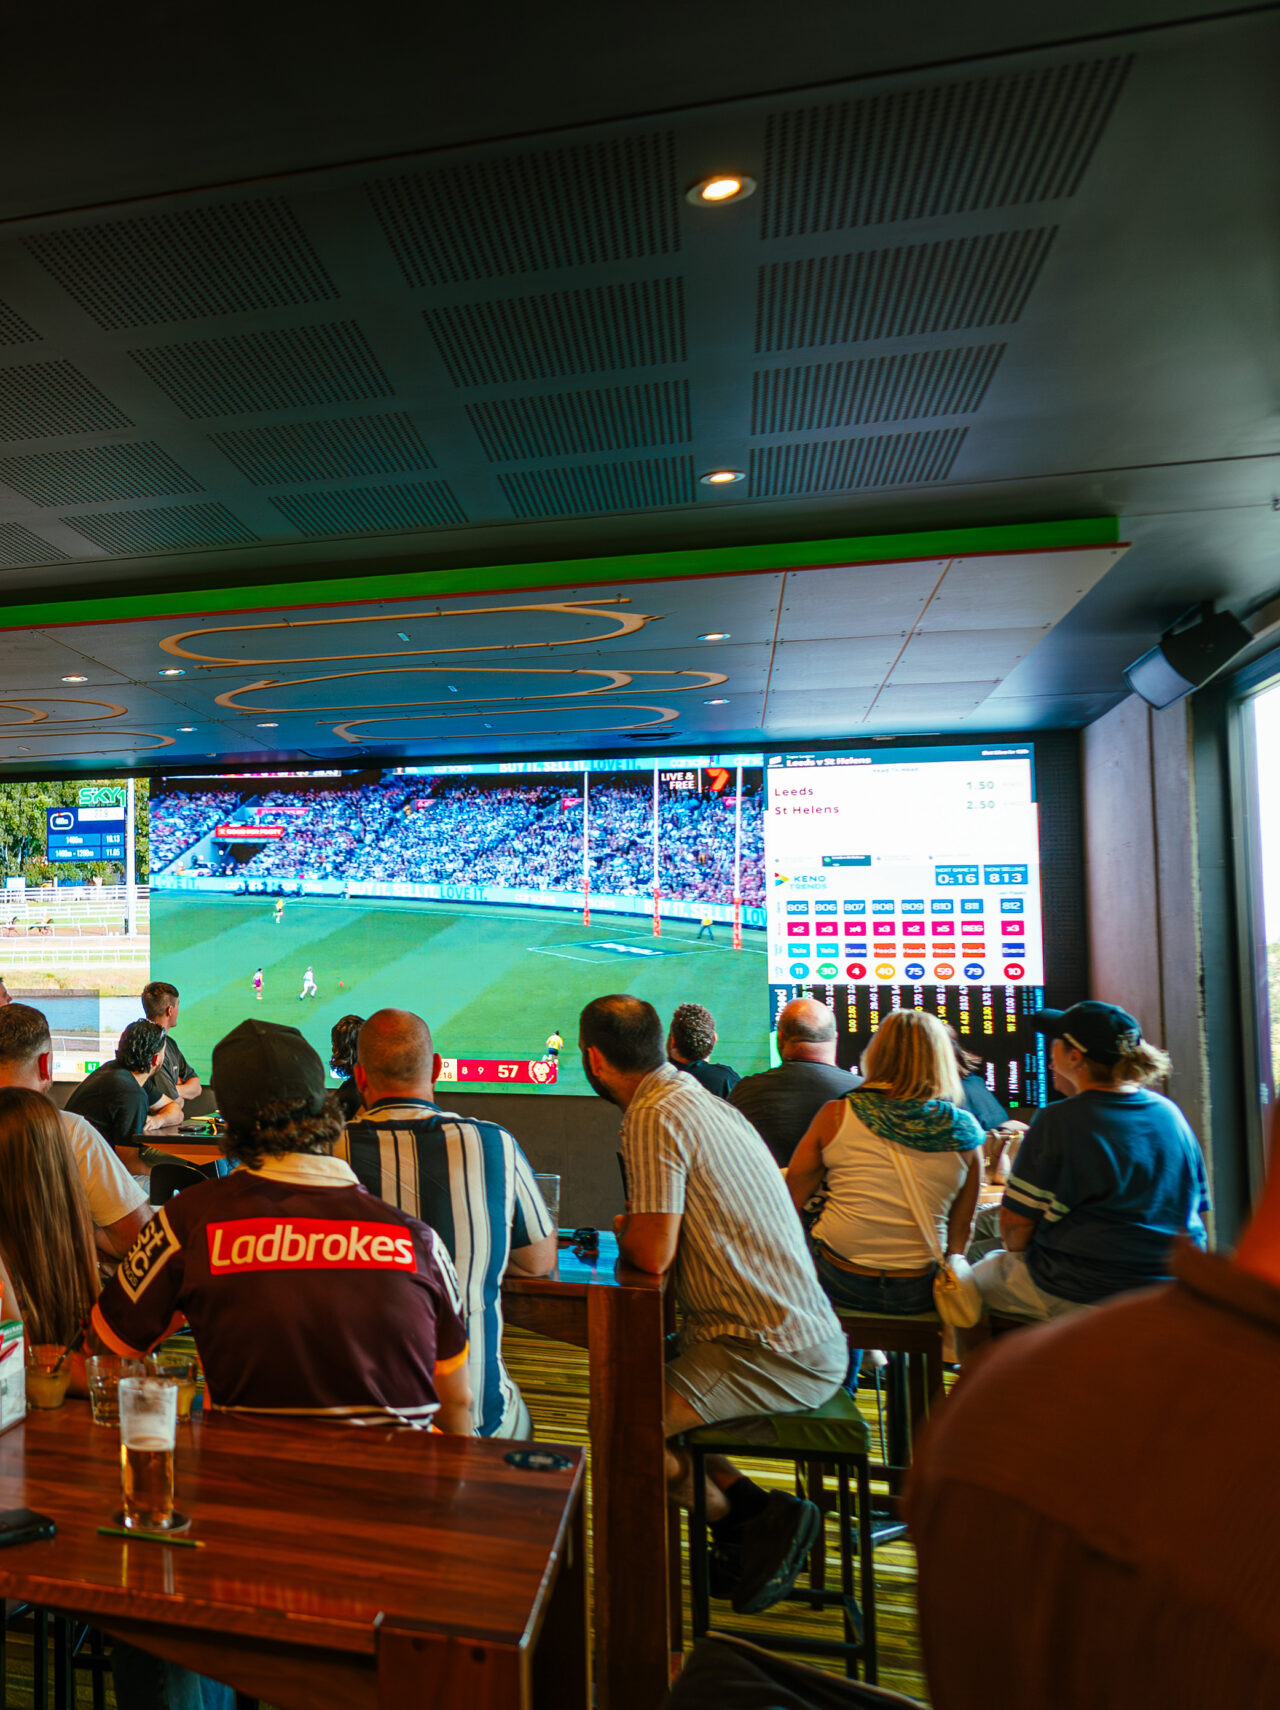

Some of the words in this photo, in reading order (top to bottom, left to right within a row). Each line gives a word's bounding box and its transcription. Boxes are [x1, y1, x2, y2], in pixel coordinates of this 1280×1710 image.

[662, 772, 684, 781] LIVE
[685, 772, 694, 780] &
[670, 780, 694, 790] FREE
[774, 787, 814, 796] Leeds
[775, 806, 788, 815] St
[793, 805, 839, 814] Helens
[966, 800, 995, 810] 2.50
[937, 874, 976, 884] 0:16
[989, 873, 1023, 883] 813
[440, 886, 468, 899] LOVE
[787, 904, 808, 912] 805
[844, 903, 864, 911] 807
[1002, 902, 1020, 910] 812
[820, 967, 836, 975] 30
[852, 967, 860, 975] 4
[877, 967, 894, 975] 40
[907, 967, 923, 975] 75
[936, 967, 952, 975] 59
[967, 967, 983, 975] 79
[1007, 967, 1021, 975] 10
[461, 1066, 468, 1075] 8
[478, 1066, 484, 1075] 9
[498, 1064, 519, 1078] 57
[211, 1225, 413, 1266] Ladbrokes
